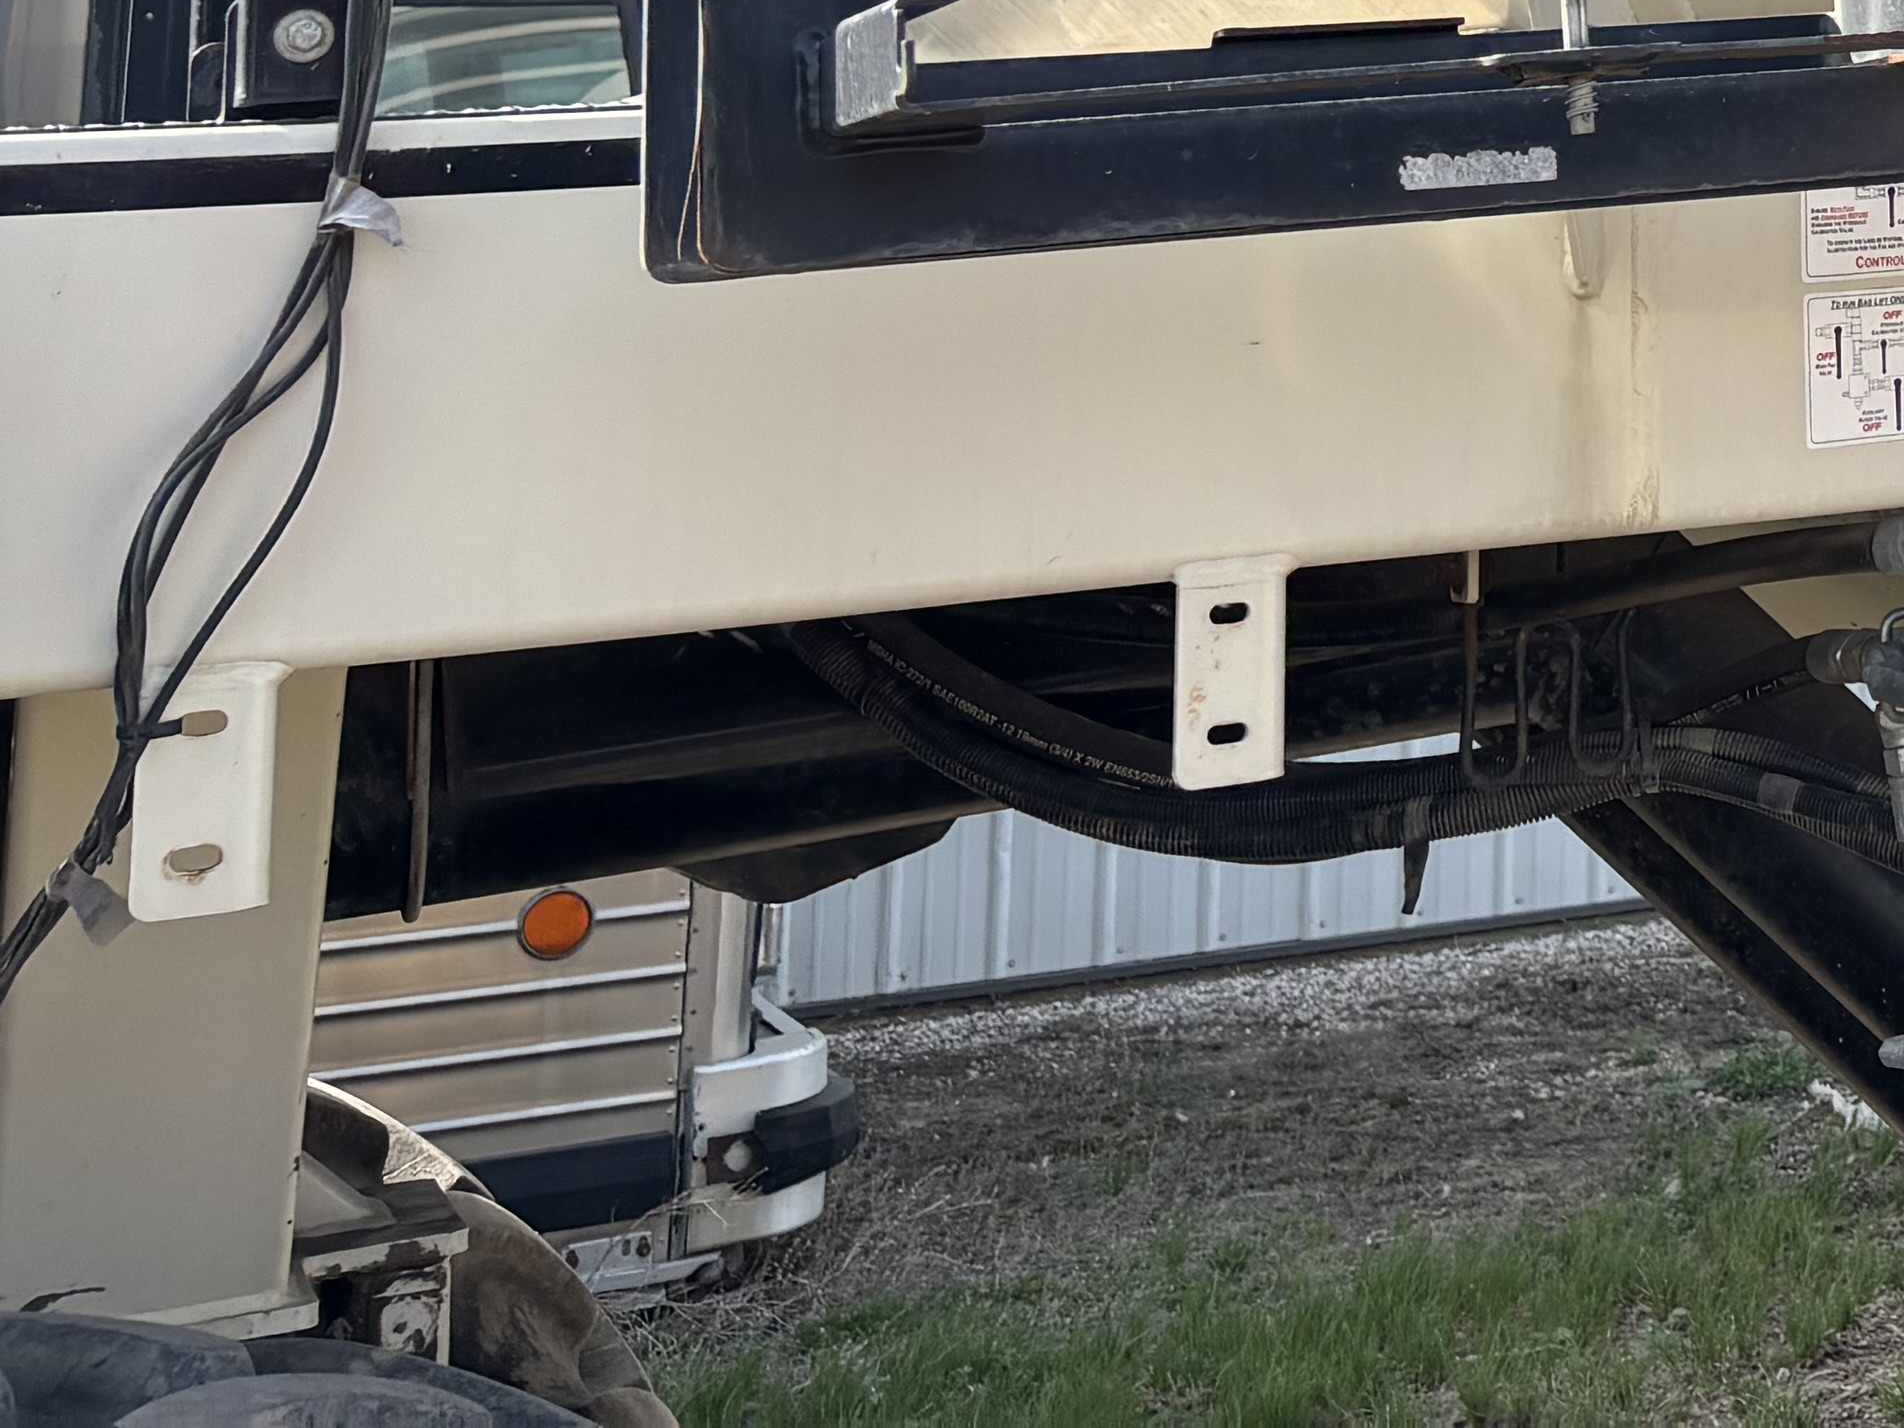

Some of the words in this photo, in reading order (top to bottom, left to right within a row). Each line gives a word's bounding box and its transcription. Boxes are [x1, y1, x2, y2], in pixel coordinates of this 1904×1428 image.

[1882, 310, 1903, 320] OFF
[1816, 351, 1836, 362] OFF
[1862, 422, 1882, 433] OFF
